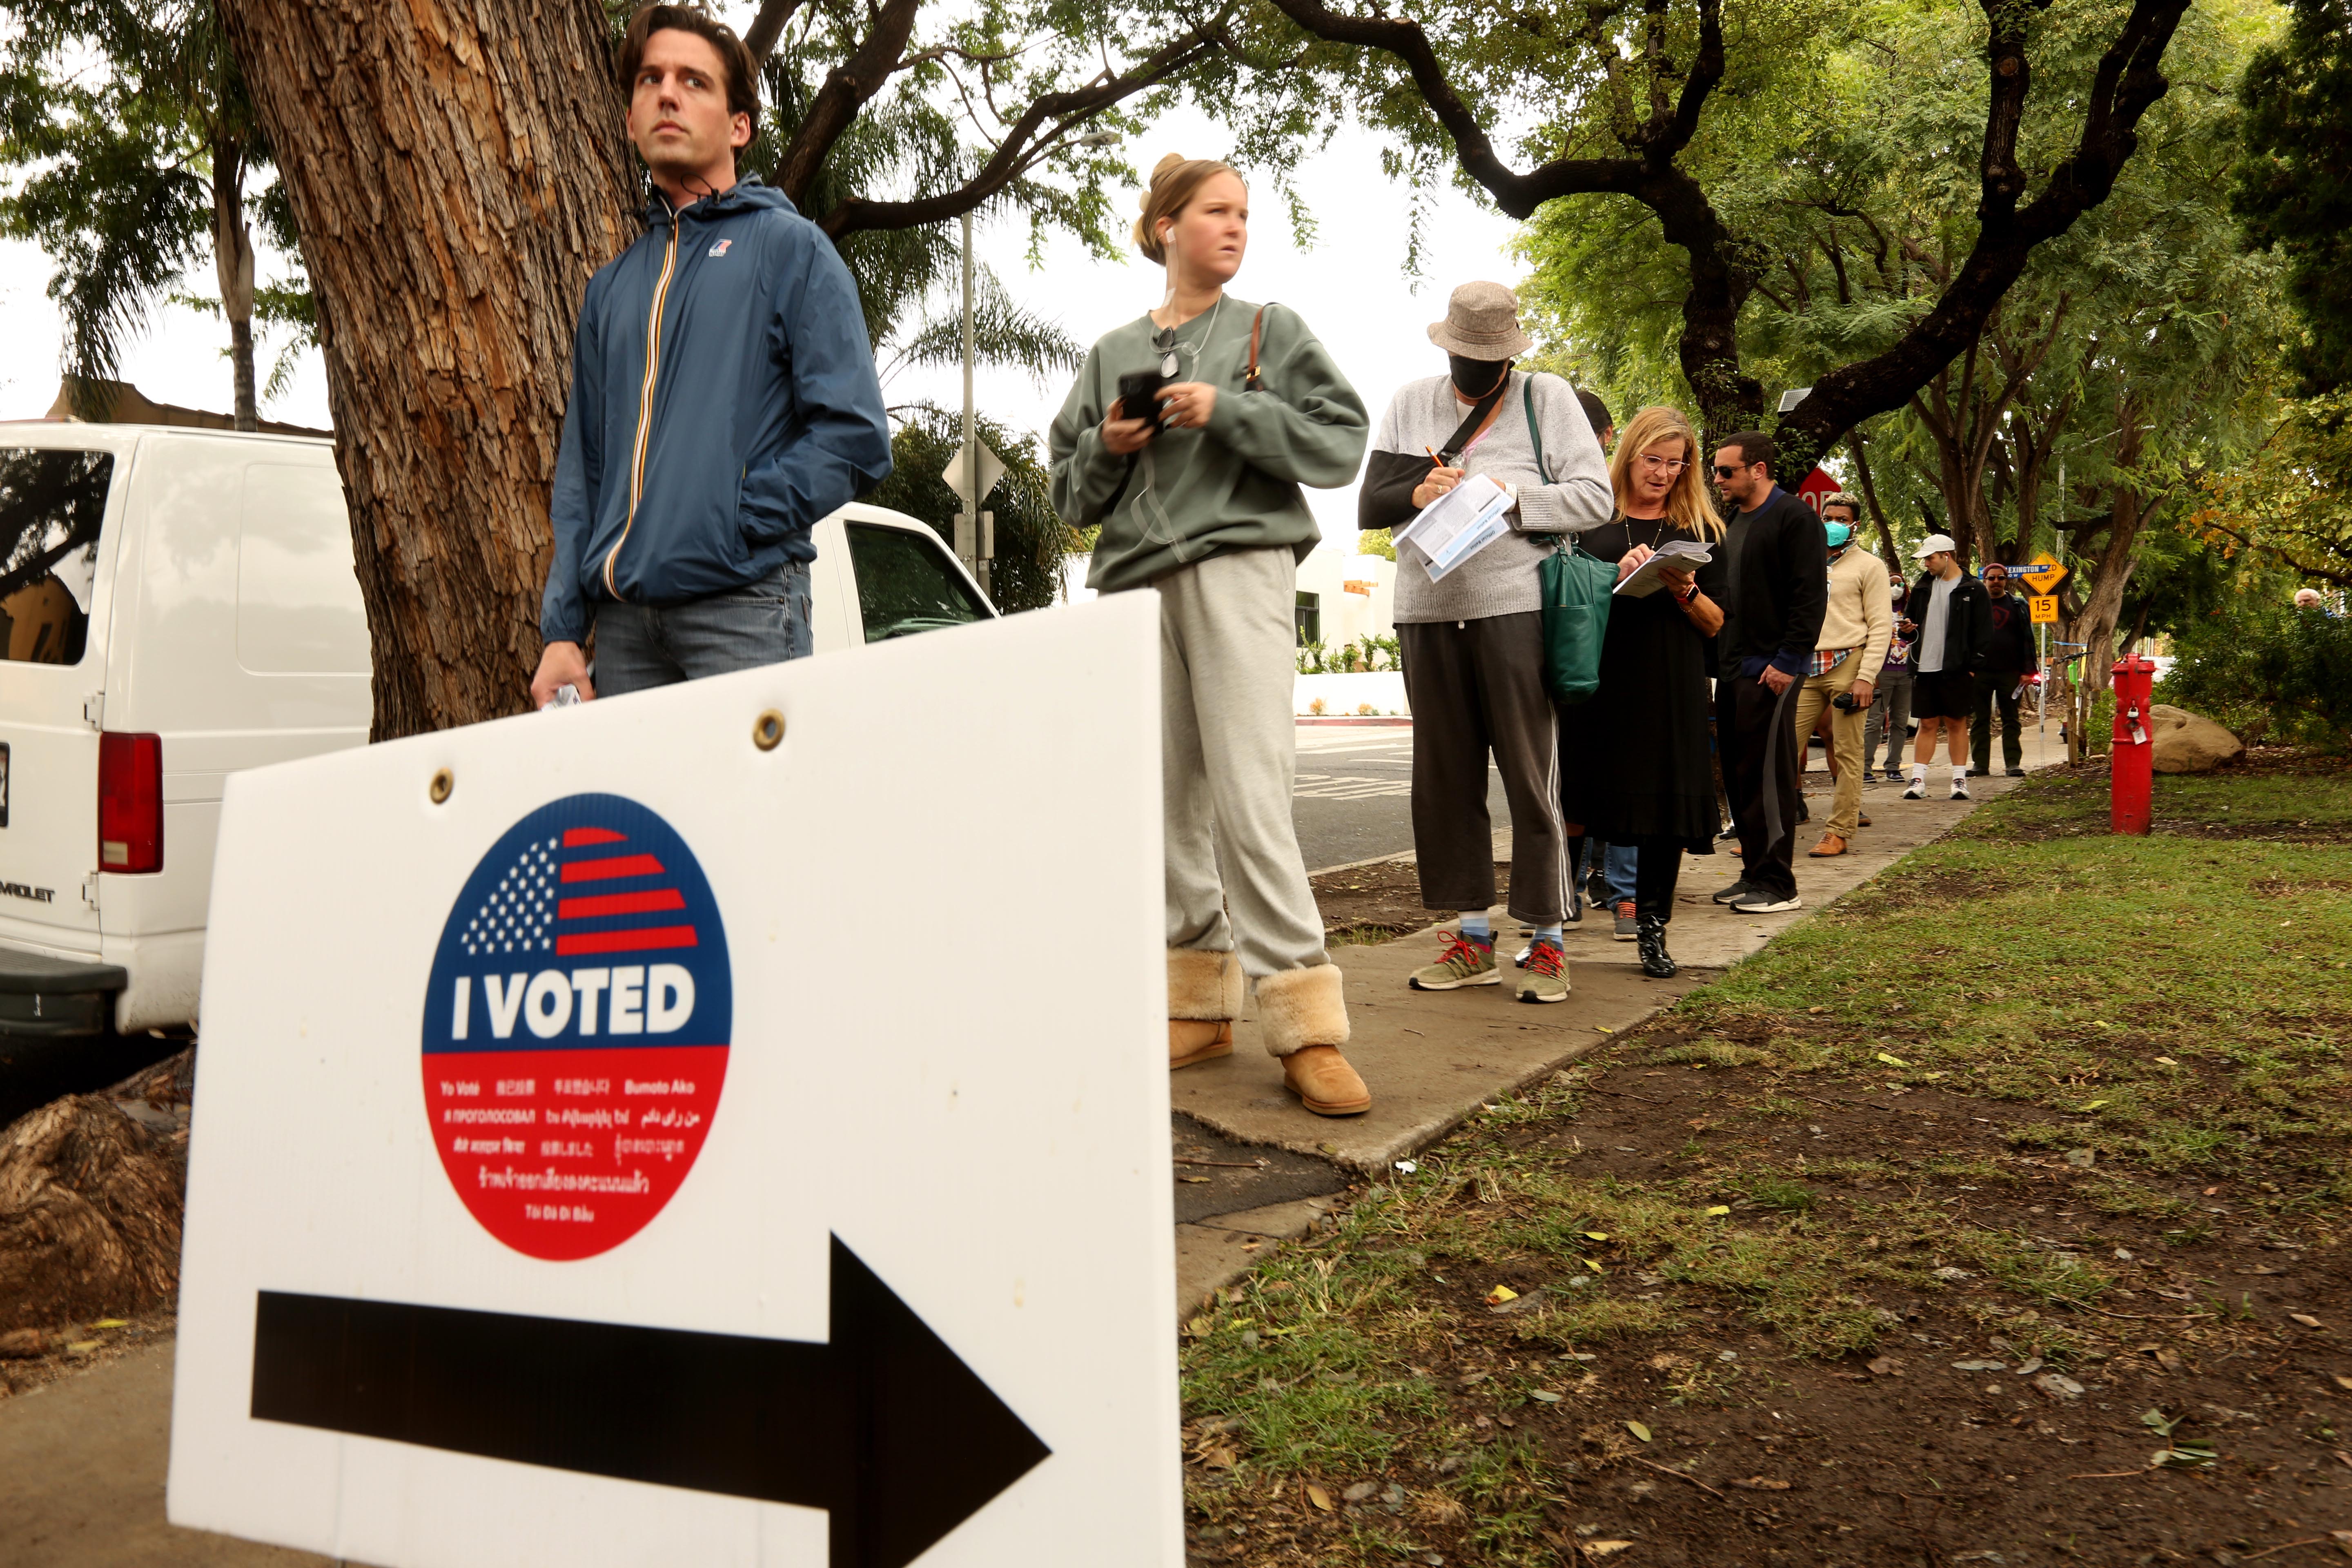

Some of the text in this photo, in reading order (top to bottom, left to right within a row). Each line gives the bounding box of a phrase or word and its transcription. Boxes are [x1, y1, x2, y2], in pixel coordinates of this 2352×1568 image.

[1470, 530, 1495, 550] Official Ballot
[2036, 599, 2051, 611] 15
[0, 880, 55, 904] VROLET
[452, 964, 695, 1040] I VOTED
[441, 1081, 480, 1096] Yo Voté
[671, 1079, 695, 1094] Ako
[452, 1109, 535, 1124] ПРОГОЛОСОВАЛ
